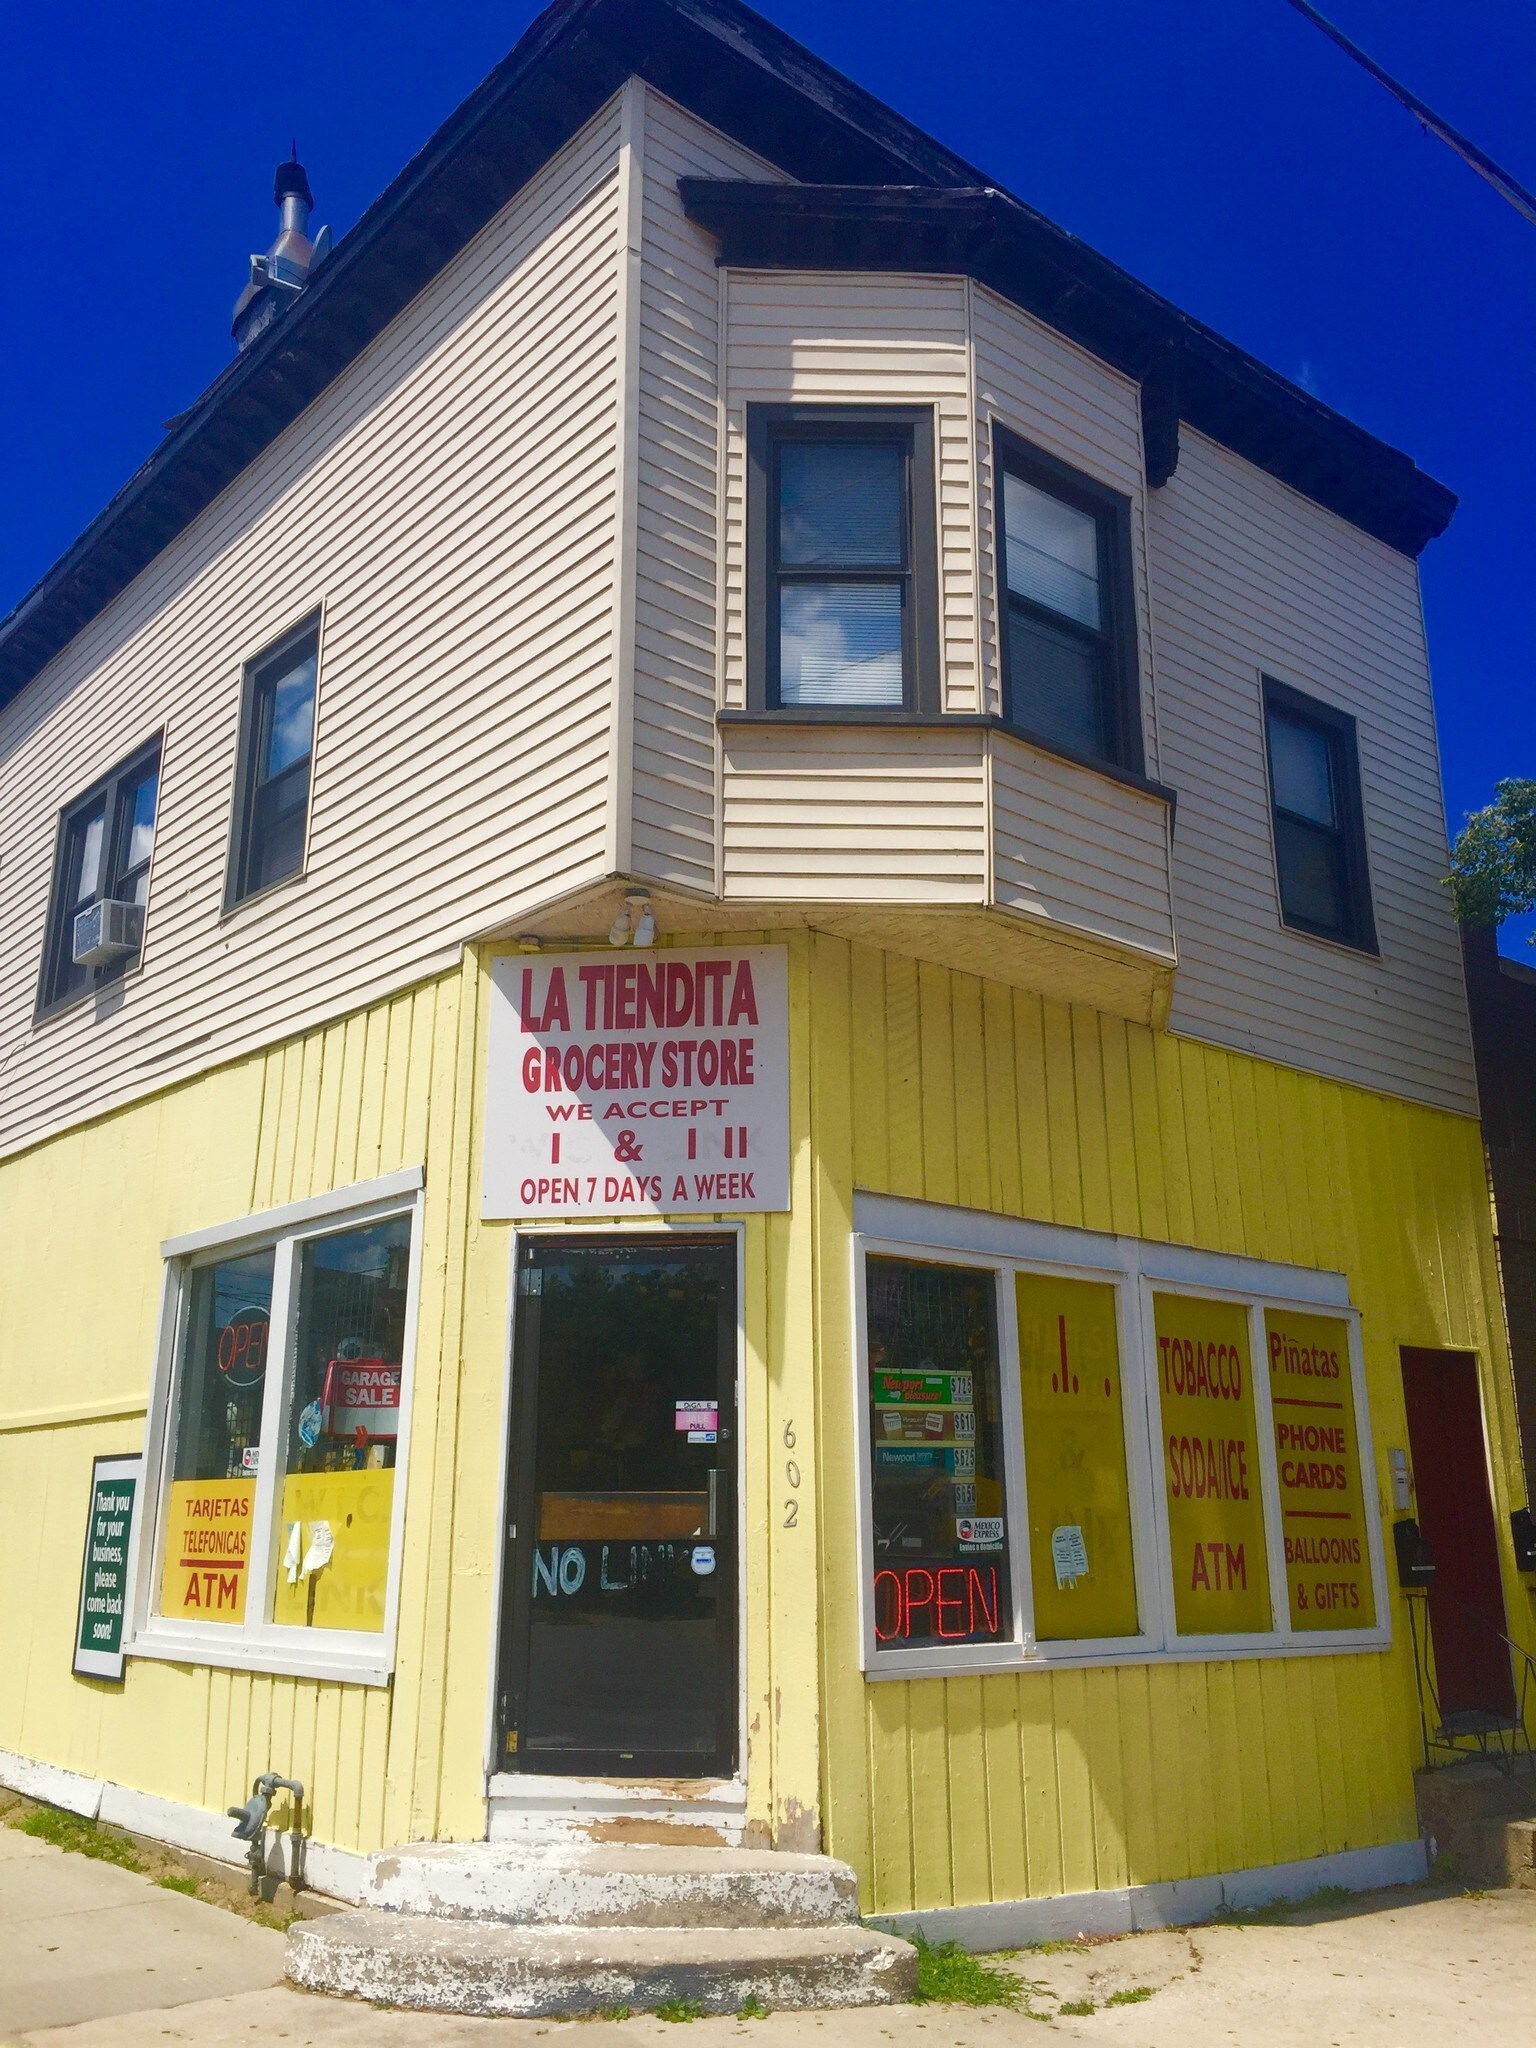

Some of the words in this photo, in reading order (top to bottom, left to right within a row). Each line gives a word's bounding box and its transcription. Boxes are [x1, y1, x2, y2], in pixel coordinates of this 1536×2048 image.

[521, 967, 570, 1033] LA
[579, 959, 759, 1030] TIENDITA
[522, 1041, 657, 1094] GROCERY
[662, 1038, 754, 1090] STORE
[546, 1104, 593, 1121] WE
[603, 1099, 729, 1120] ACCEPT
[614, 1129, 643, 1163] &
[520, 1177, 579, 1205] OPEN
[587, 1177, 598, 1203] 7
[604, 1175, 662, 1203] DAYS
[672, 1175, 688, 1201] A
[694, 1172, 756, 1200] WEEK
[1269, 1331, 1340, 1379] Piñatas
[341, 1371, 401, 1386] GARAGE
[1159, 1336, 1241, 1401] TOBACCO
[345, 1388, 394, 1405] SALE
[1277, 1423, 1346, 1453] PHONE
[882, 1452, 916, 1464] Newport
[1281, 1461, 1347, 1490] CARDS
[96, 1491, 115, 1512] Thank
[115, 1496, 131, 1516] you
[185, 1498, 249, 1521] TARJETAS
[96, 1516, 106, 1537] for
[106, 1521, 124, 1541] your
[974, 1521, 1000, 1530] MEXICO
[974, 1530, 1000, 1538] EXPRESS
[92, 1541, 123, 1565] business,
[183, 1530, 246, 1555] TELEFONICAS
[1284, 1537, 1361, 1564] BALLOONS
[94, 1567, 117, 1592] please
[531, 1546, 586, 1598] NO
[1191, 1543, 1247, 1591] ATM
[87, 1596, 105, 1612] come
[106, 1593, 122, 1614] back
[184, 1573, 239, 1610] ATM
[874, 1567, 998, 1640] OPEN
[1297, 1583, 1309, 1610] &
[1315, 1583, 1360, 1610] GIFTS
[93, 1620, 113, 1640] soon!
